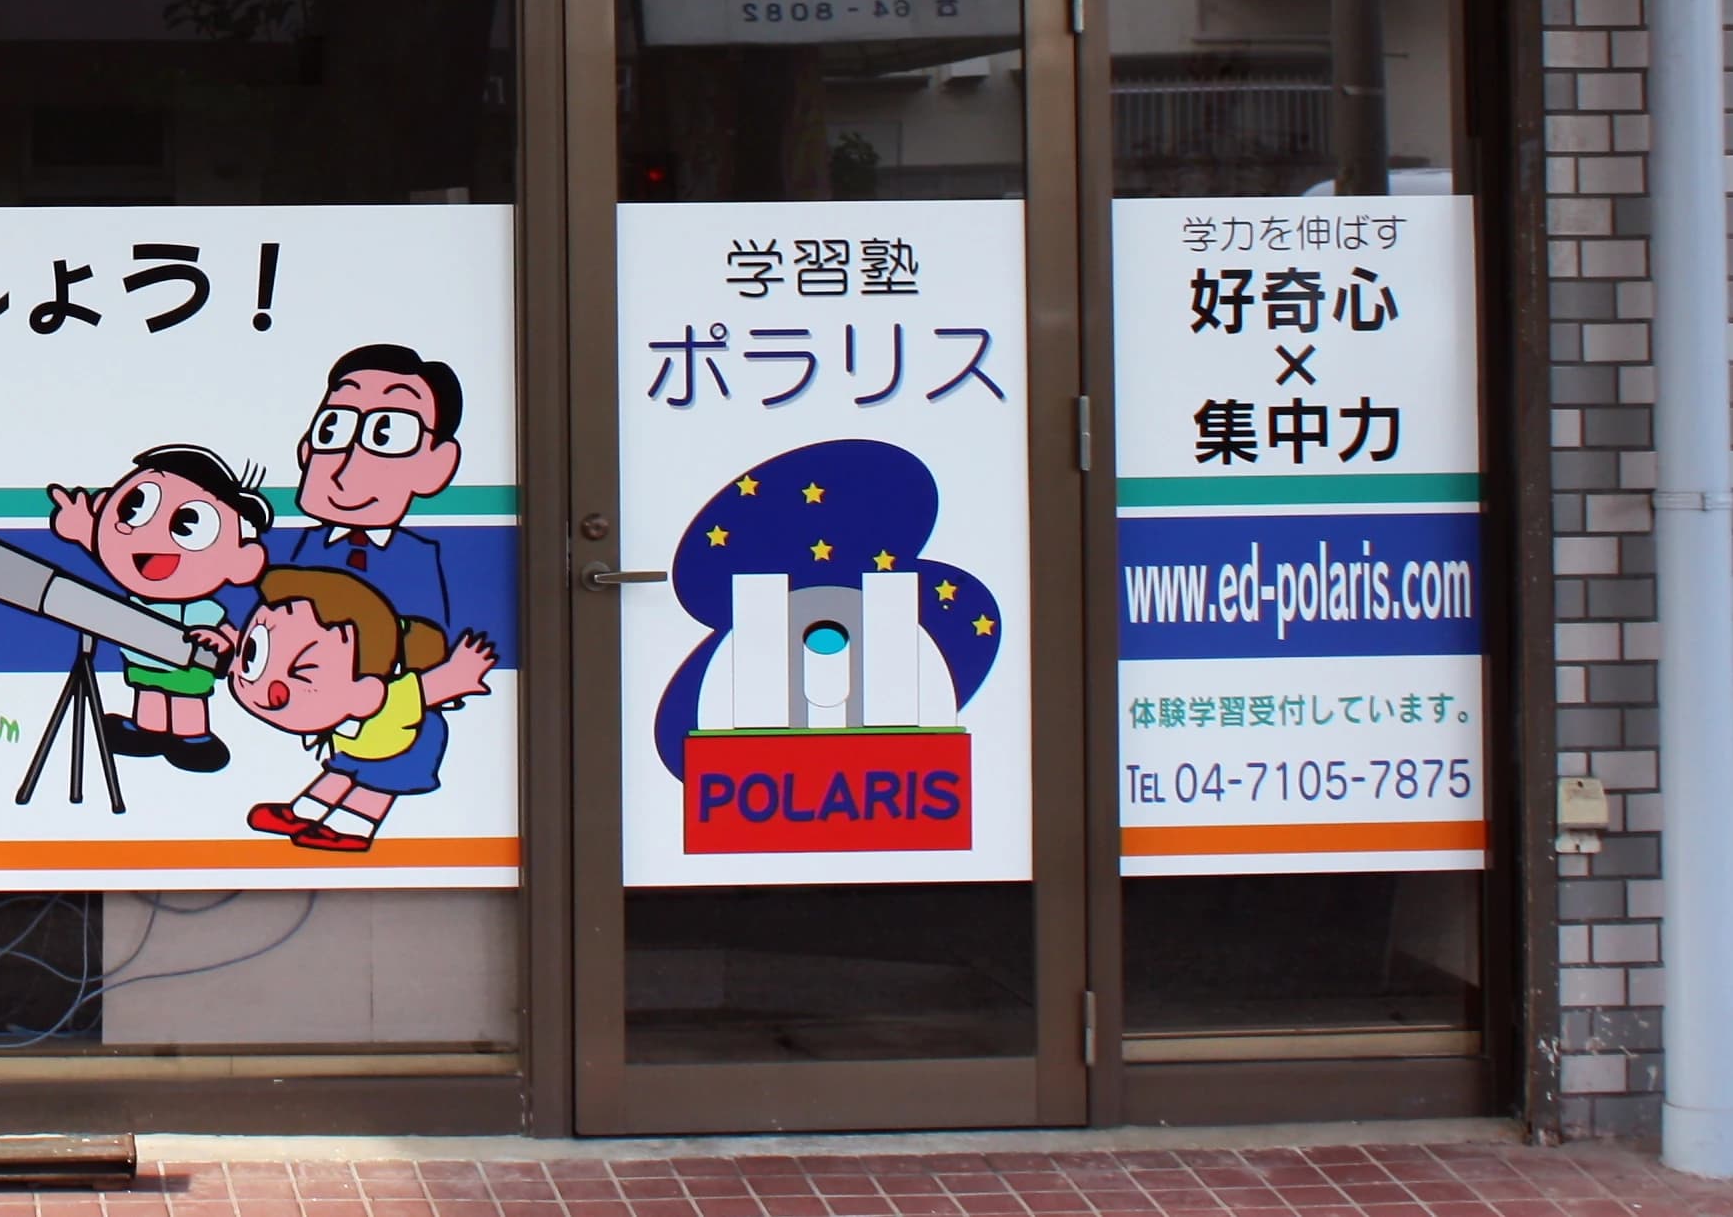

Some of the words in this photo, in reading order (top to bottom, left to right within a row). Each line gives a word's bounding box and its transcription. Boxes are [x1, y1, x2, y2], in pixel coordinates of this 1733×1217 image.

[1182, 214, 1409, 252] 学力を伸ばす
[725, 237, 921, 299] 学習塾
[1190, 266, 1400, 335] 好奇心
[648, 321, 1006, 407] ポラリス
[1193, 396, 1402, 466] 集中力
[1124, 540, 1472, 641] www.ed-polaris.com
[1128, 692, 1471, 730] 体験学習受付しています。
[698, 769, 963, 823] POLARIS
[1125, 764, 1166, 804] TEL
[1174, 758, 1472, 804] 04-7105-7875
